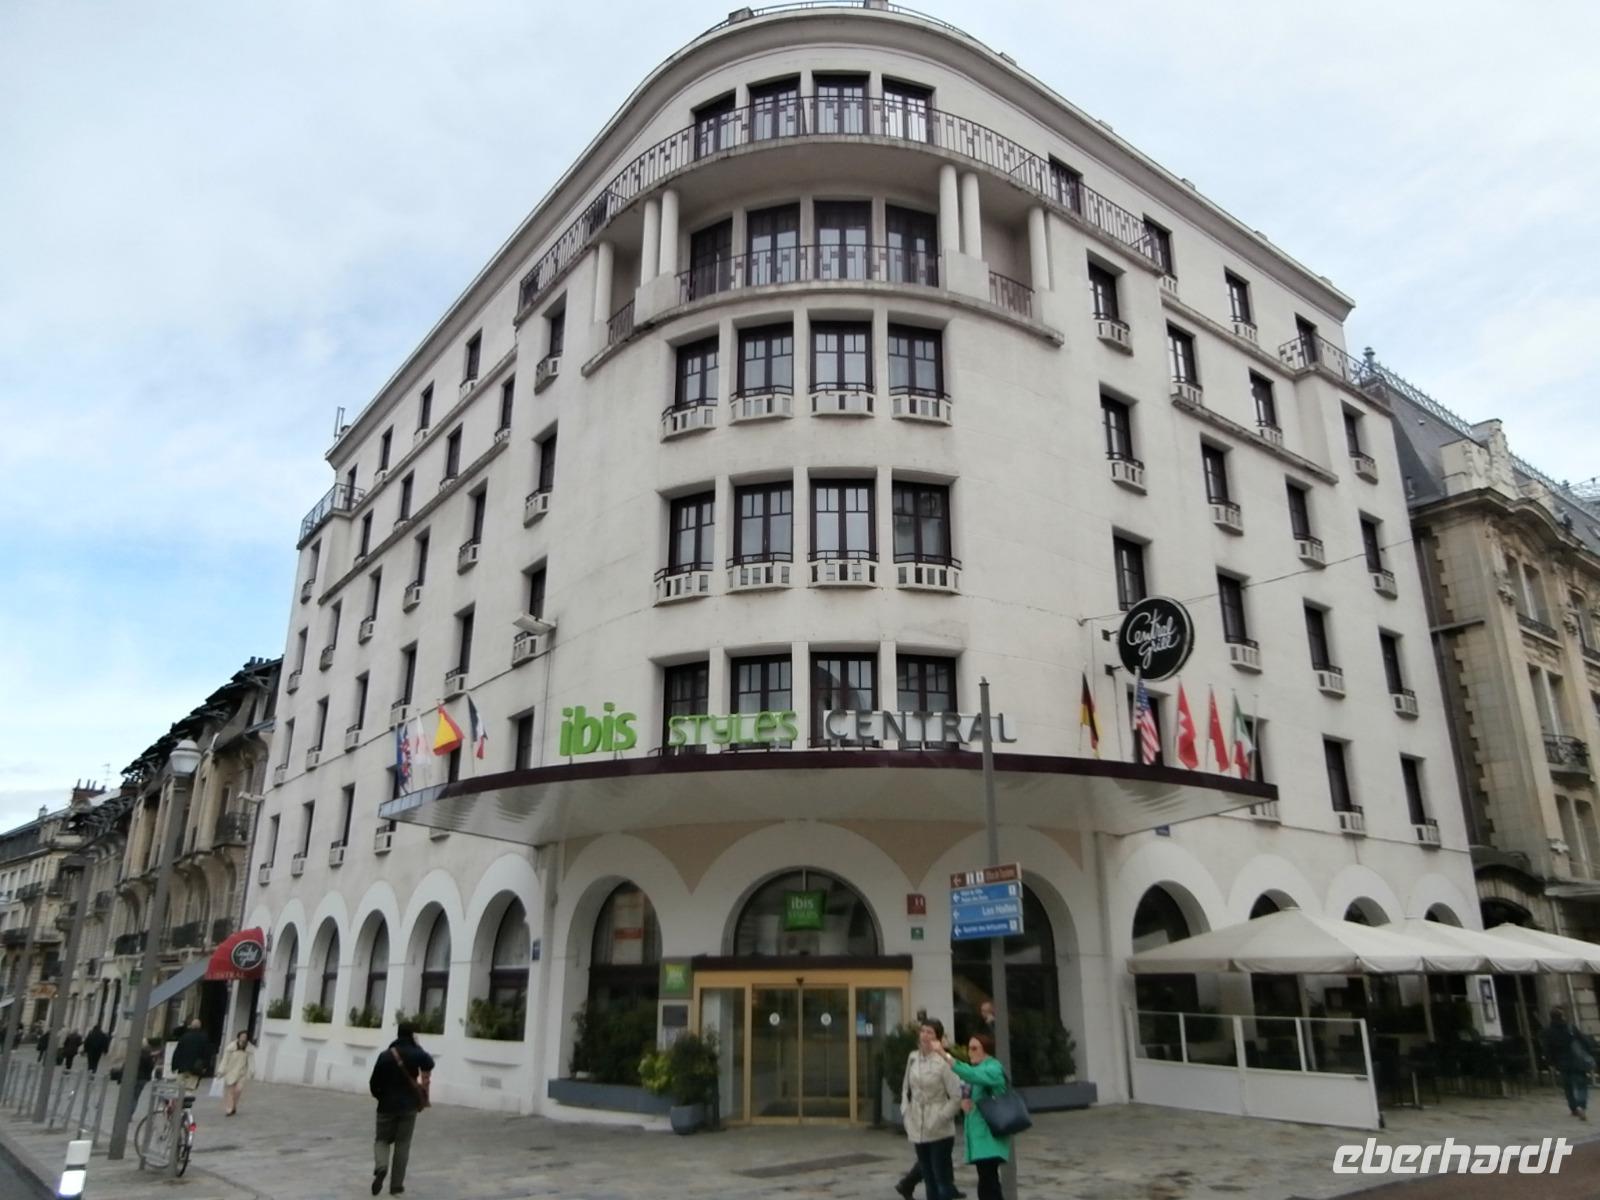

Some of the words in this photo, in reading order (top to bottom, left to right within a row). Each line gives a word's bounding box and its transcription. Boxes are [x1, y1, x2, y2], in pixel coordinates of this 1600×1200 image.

[1126, 609, 1177, 646] Central
[560, 702, 637, 756] ibis
[825, 709, 1017, 745] CENTRAL
